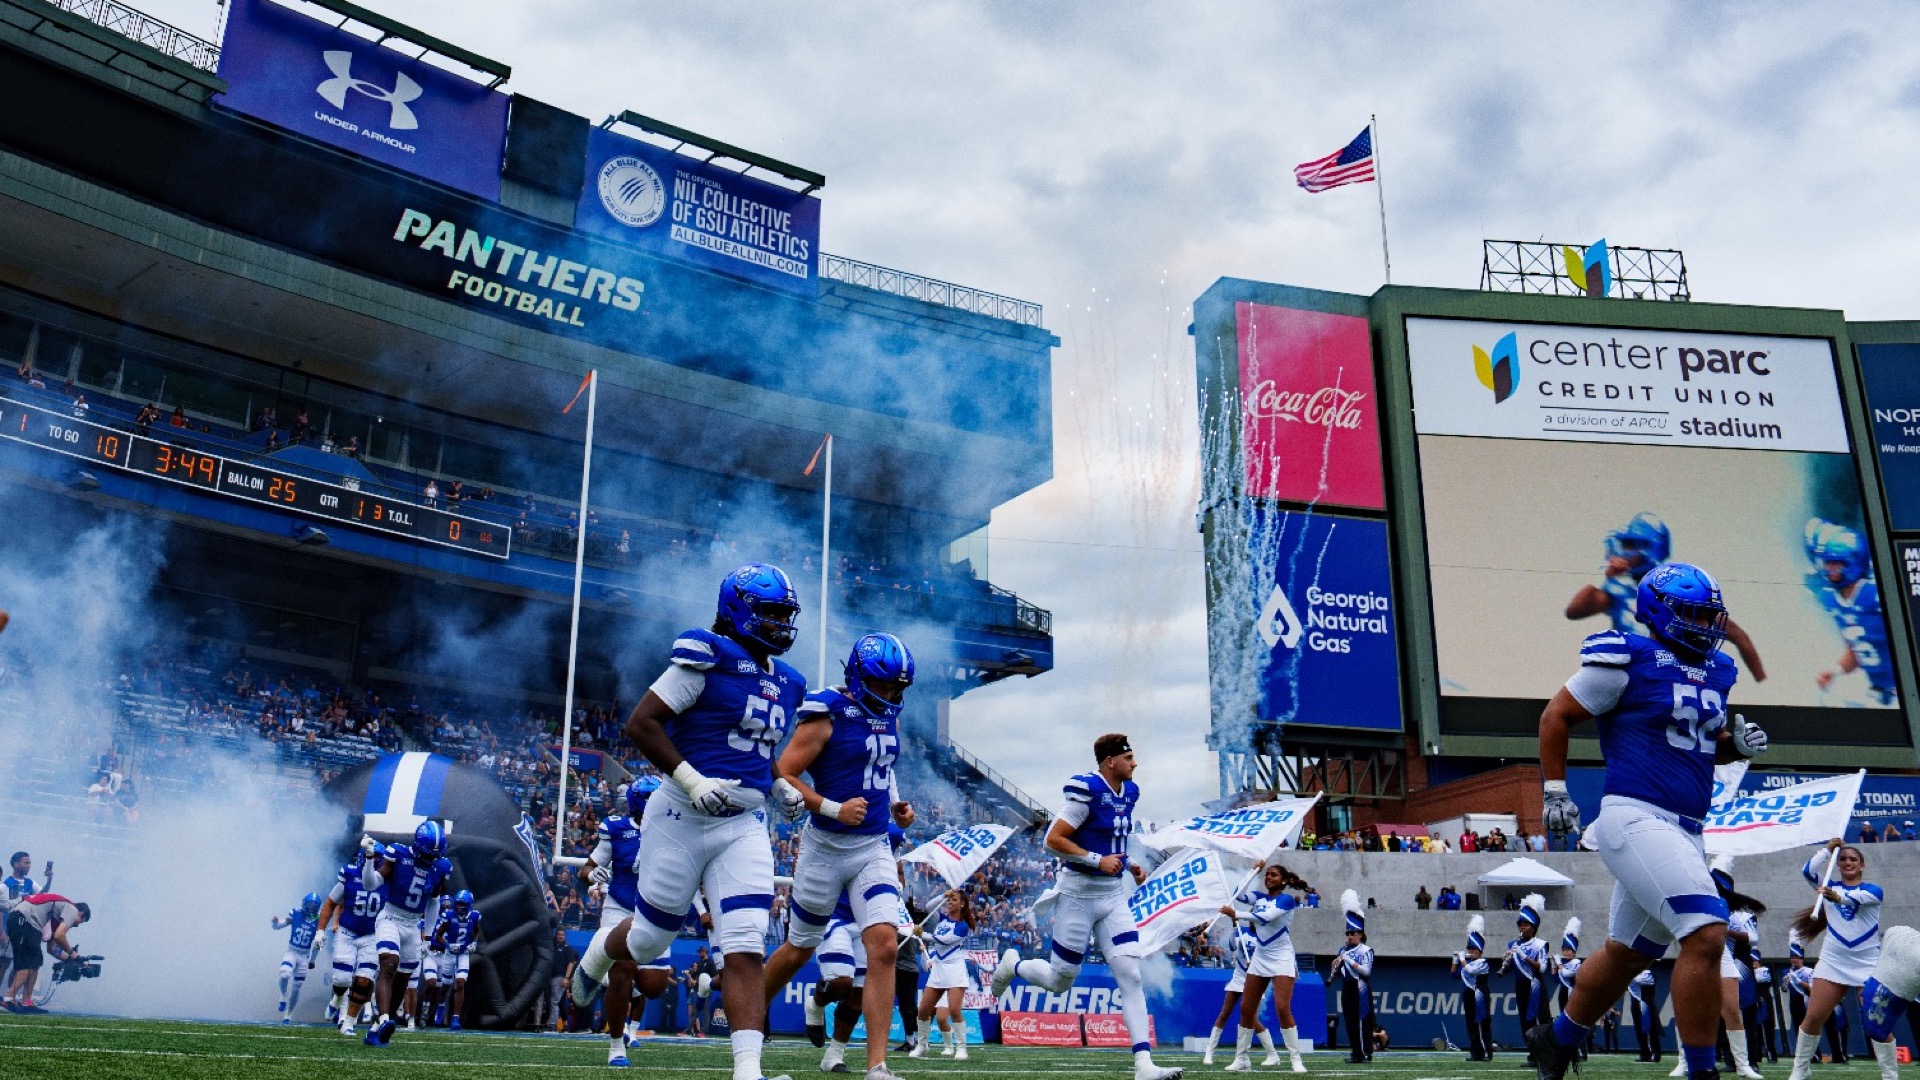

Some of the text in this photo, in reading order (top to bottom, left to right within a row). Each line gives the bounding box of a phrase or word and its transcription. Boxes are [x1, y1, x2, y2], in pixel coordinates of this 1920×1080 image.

[314, 111, 416, 154] UNDER ARMOUR
[616, 158, 638, 168] BLUE
[676, 170, 723, 191] THE OFFICIAL
[674, 176, 792, 233] NIL COLLECTIVE
[672, 199, 809, 261] OF GSU ATHLETICS
[393, 208, 645, 312] PANTHERS
[674, 226, 806, 275] ALLBLUEALLNIL.COM
[447, 270, 585, 327] FOOTBALL
[1529, 337, 1772, 382] center parc
[1247, 379, 1368, 430] Coca-Cola
[1538, 380, 1775, 407] CREDIT UNION
[1544, 413, 1668, 430] a division of APCU
[1680, 417, 1783, 439] stadium
[49, 424, 62, 439] TO
[64, 429, 80, 443] GO
[97, 435, 119, 459] 10
[1881, 444, 1897, 453] We
[156, 446, 214, 483] 3:49
[227, 472, 251, 489] BALL
[250, 477, 264, 491] ON
[269, 477, 296, 502] 25
[319, 494, 339, 508] QTR
[373, 504, 382, 520] 3
[388, 509, 413, 526] T.O.L.
[450, 520, 461, 541] 0
[1306, 586, 1389, 614] Georgia
[1307, 608, 1388, 634] Natural
[1308, 632, 1351, 654] Gas
[1666, 683, 1724, 754] 52
[862, 734, 897, 790] 15
[1763, 776, 1796, 788] JOIN
[1863, 792, 1915, 806] TODAY!
[1111, 815, 1129, 854] 11
[352, 891, 381, 918] 50
[405, 876, 427, 909] 5
